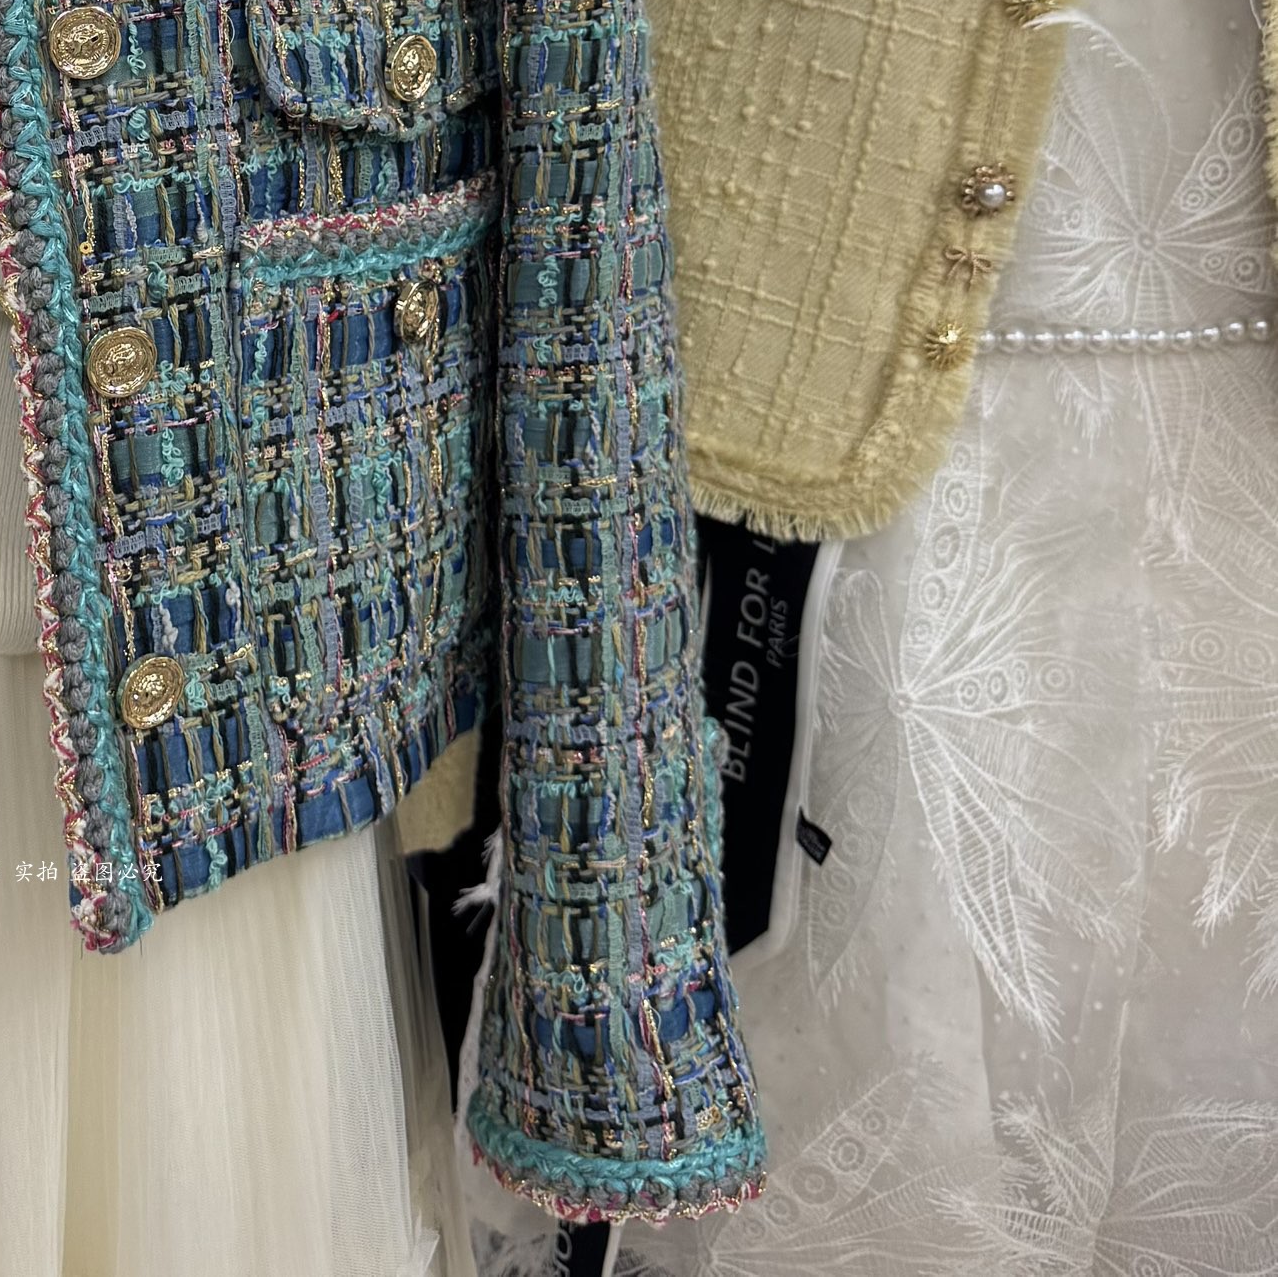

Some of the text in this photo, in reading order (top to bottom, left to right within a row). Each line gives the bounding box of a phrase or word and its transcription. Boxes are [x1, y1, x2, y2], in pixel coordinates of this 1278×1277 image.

[736, 568, 771, 648] FOR
[767, 596, 789, 669] PARIS
[722, 661, 760, 783] BLIND
